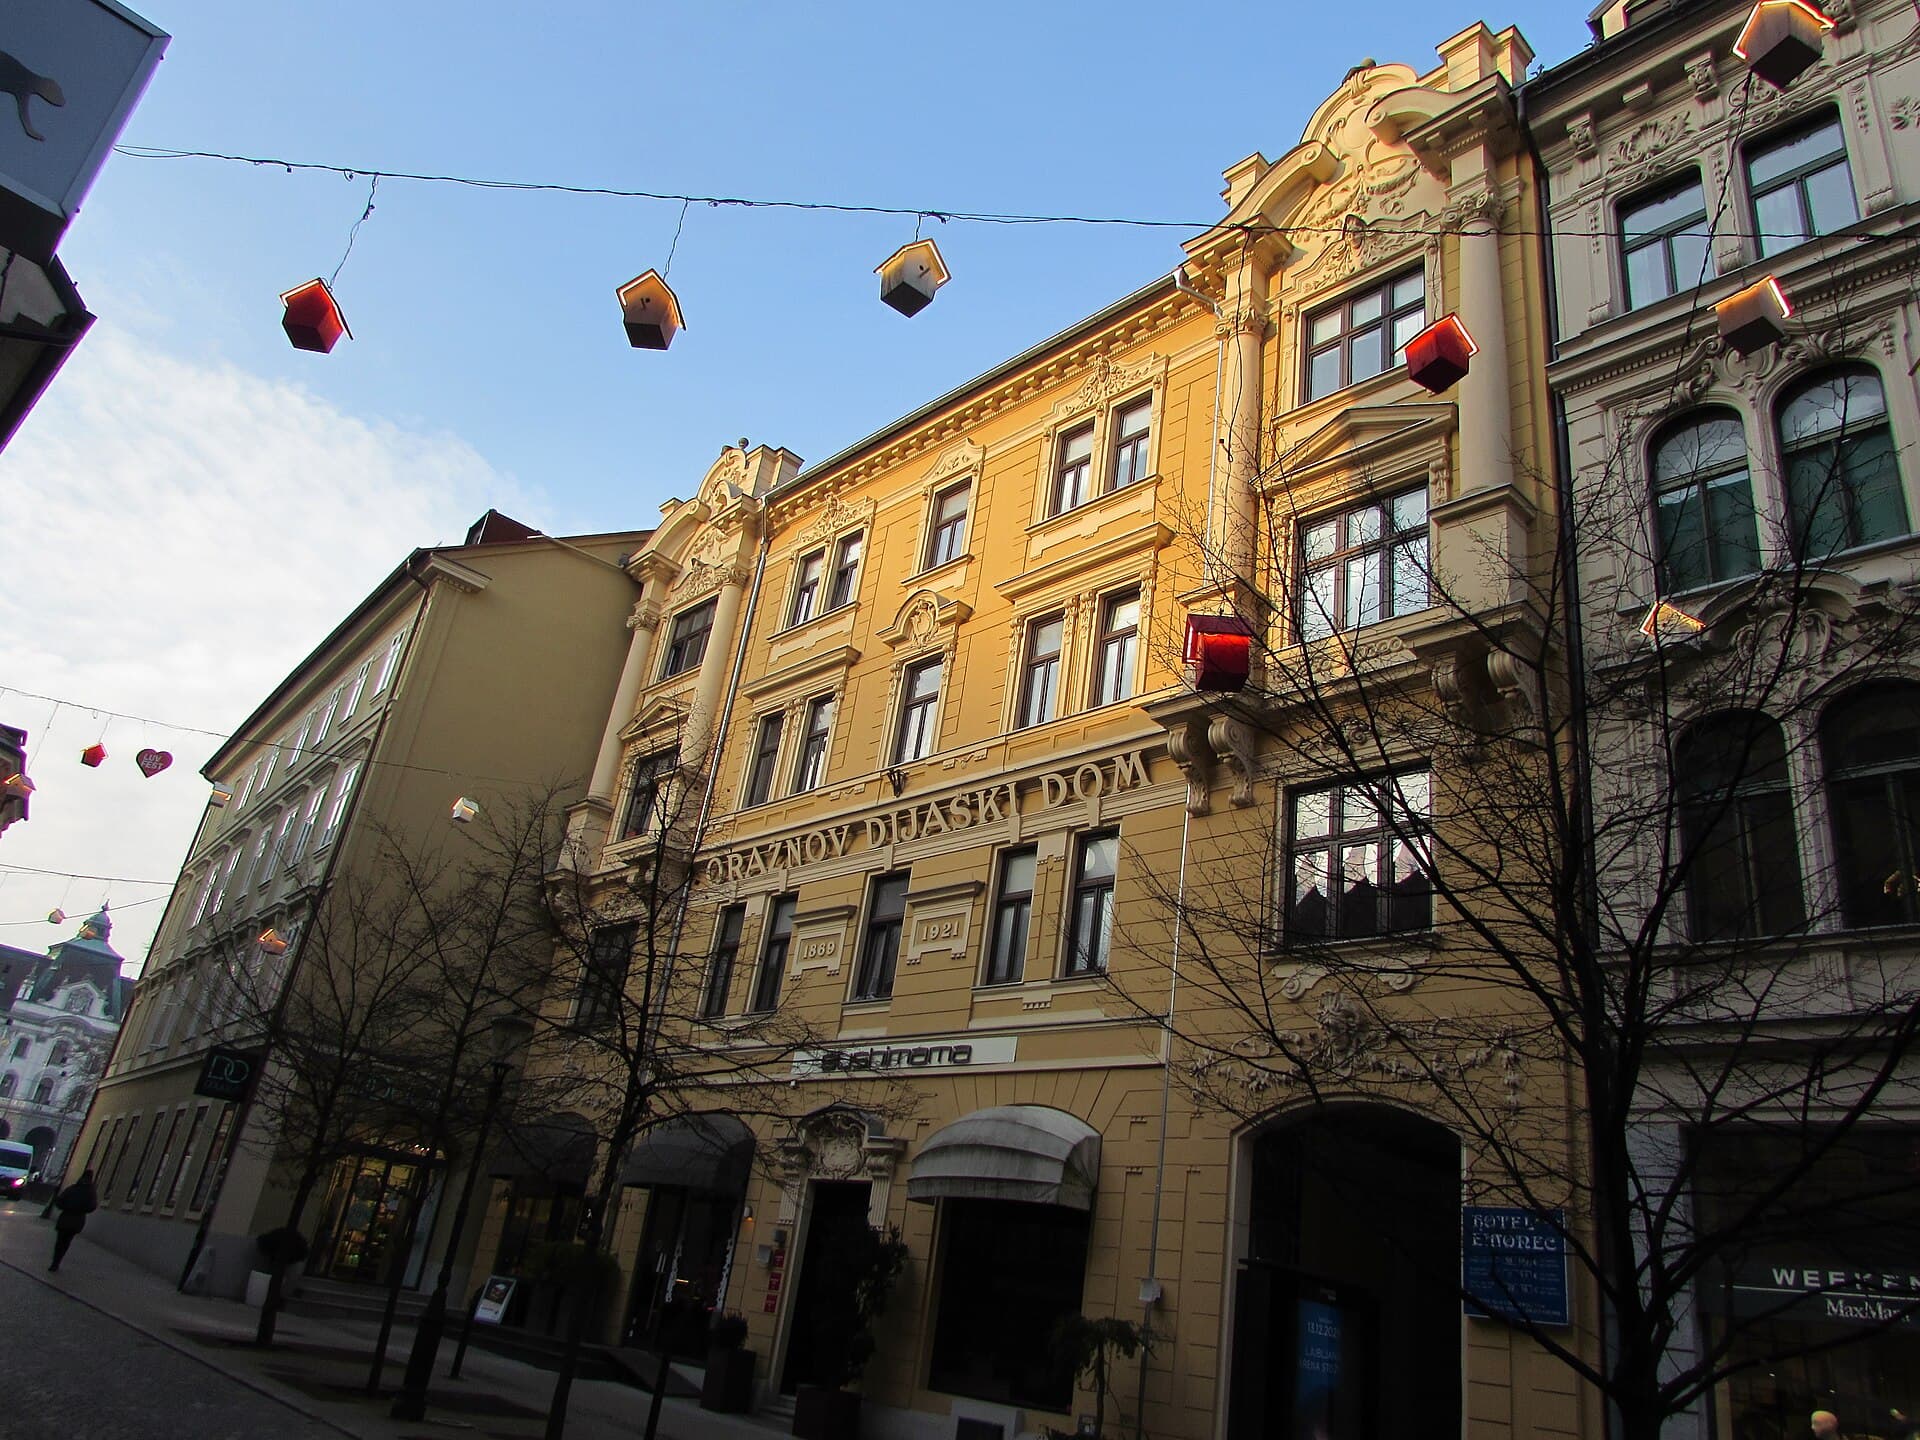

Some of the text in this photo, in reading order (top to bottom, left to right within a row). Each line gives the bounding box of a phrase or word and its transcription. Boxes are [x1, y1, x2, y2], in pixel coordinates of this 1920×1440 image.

[141, 761, 164, 769] FEST
[143, 753, 162, 762] LUV
[706, 750, 1152, 885] ORAŽNOV DIJAŠKI DOM
[922, 920, 960, 941] 1921
[1472, 1213, 1536, 1231] HOTEL
